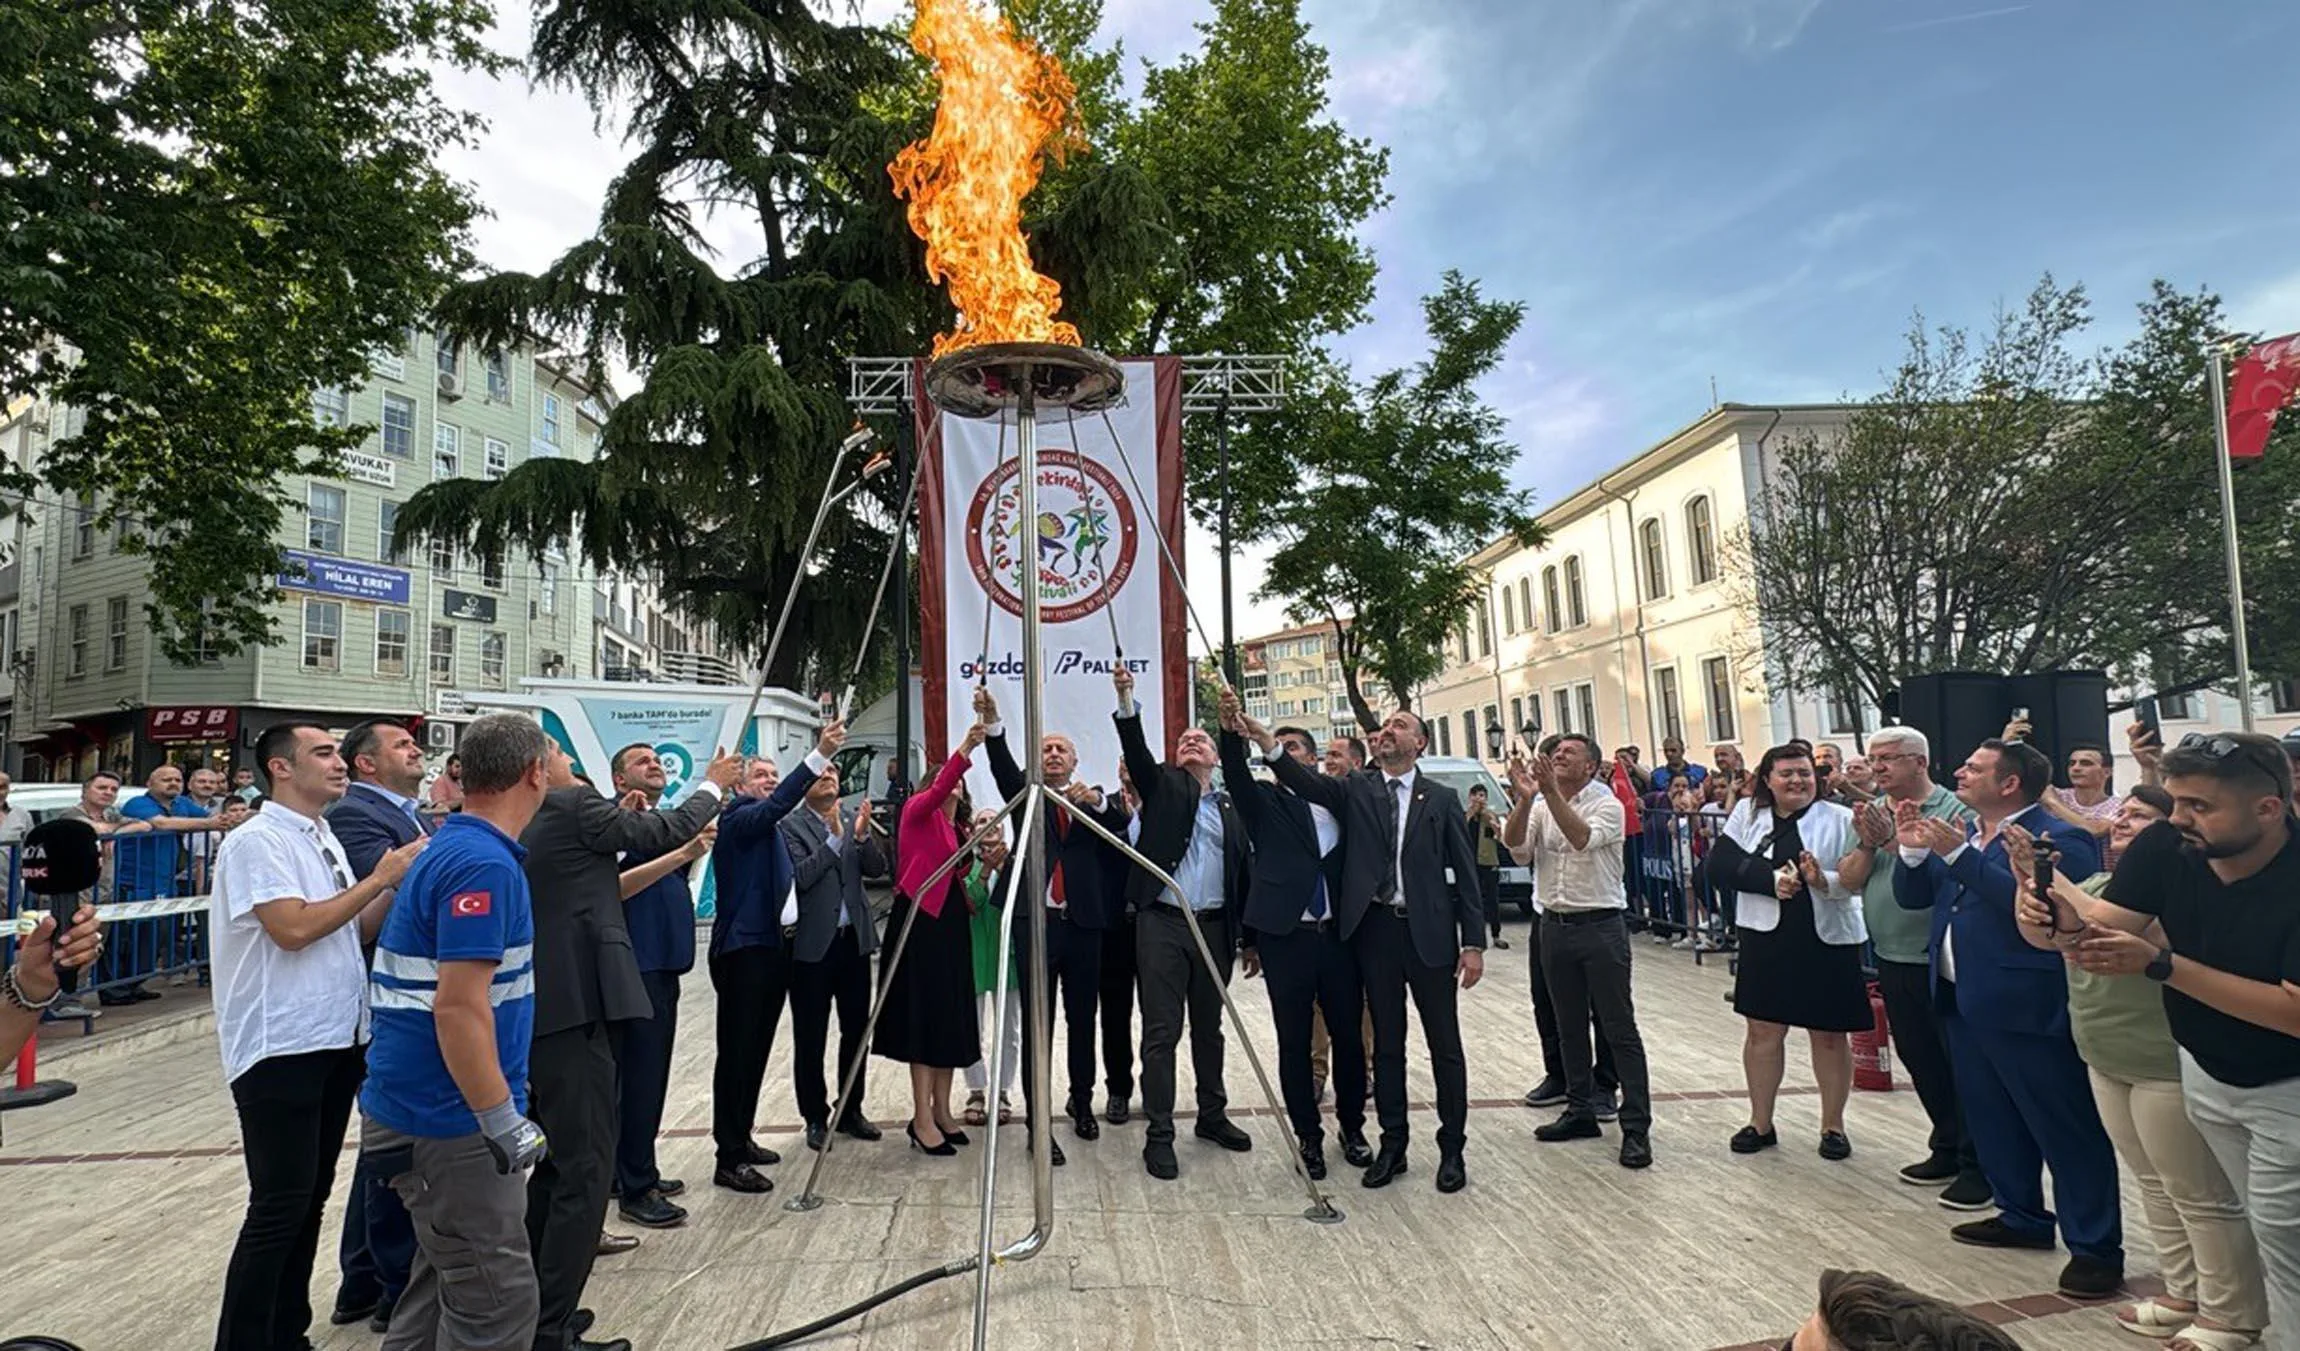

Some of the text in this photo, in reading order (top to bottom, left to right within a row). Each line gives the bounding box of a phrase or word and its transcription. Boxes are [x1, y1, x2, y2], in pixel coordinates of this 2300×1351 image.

[325, 570, 360, 586] HİLAL
[362, 576, 393, 591] EREN
[1083, 659, 1150, 674] PALET
[611, 711, 616, 720] 7
[617, 710, 644, 720] banka
